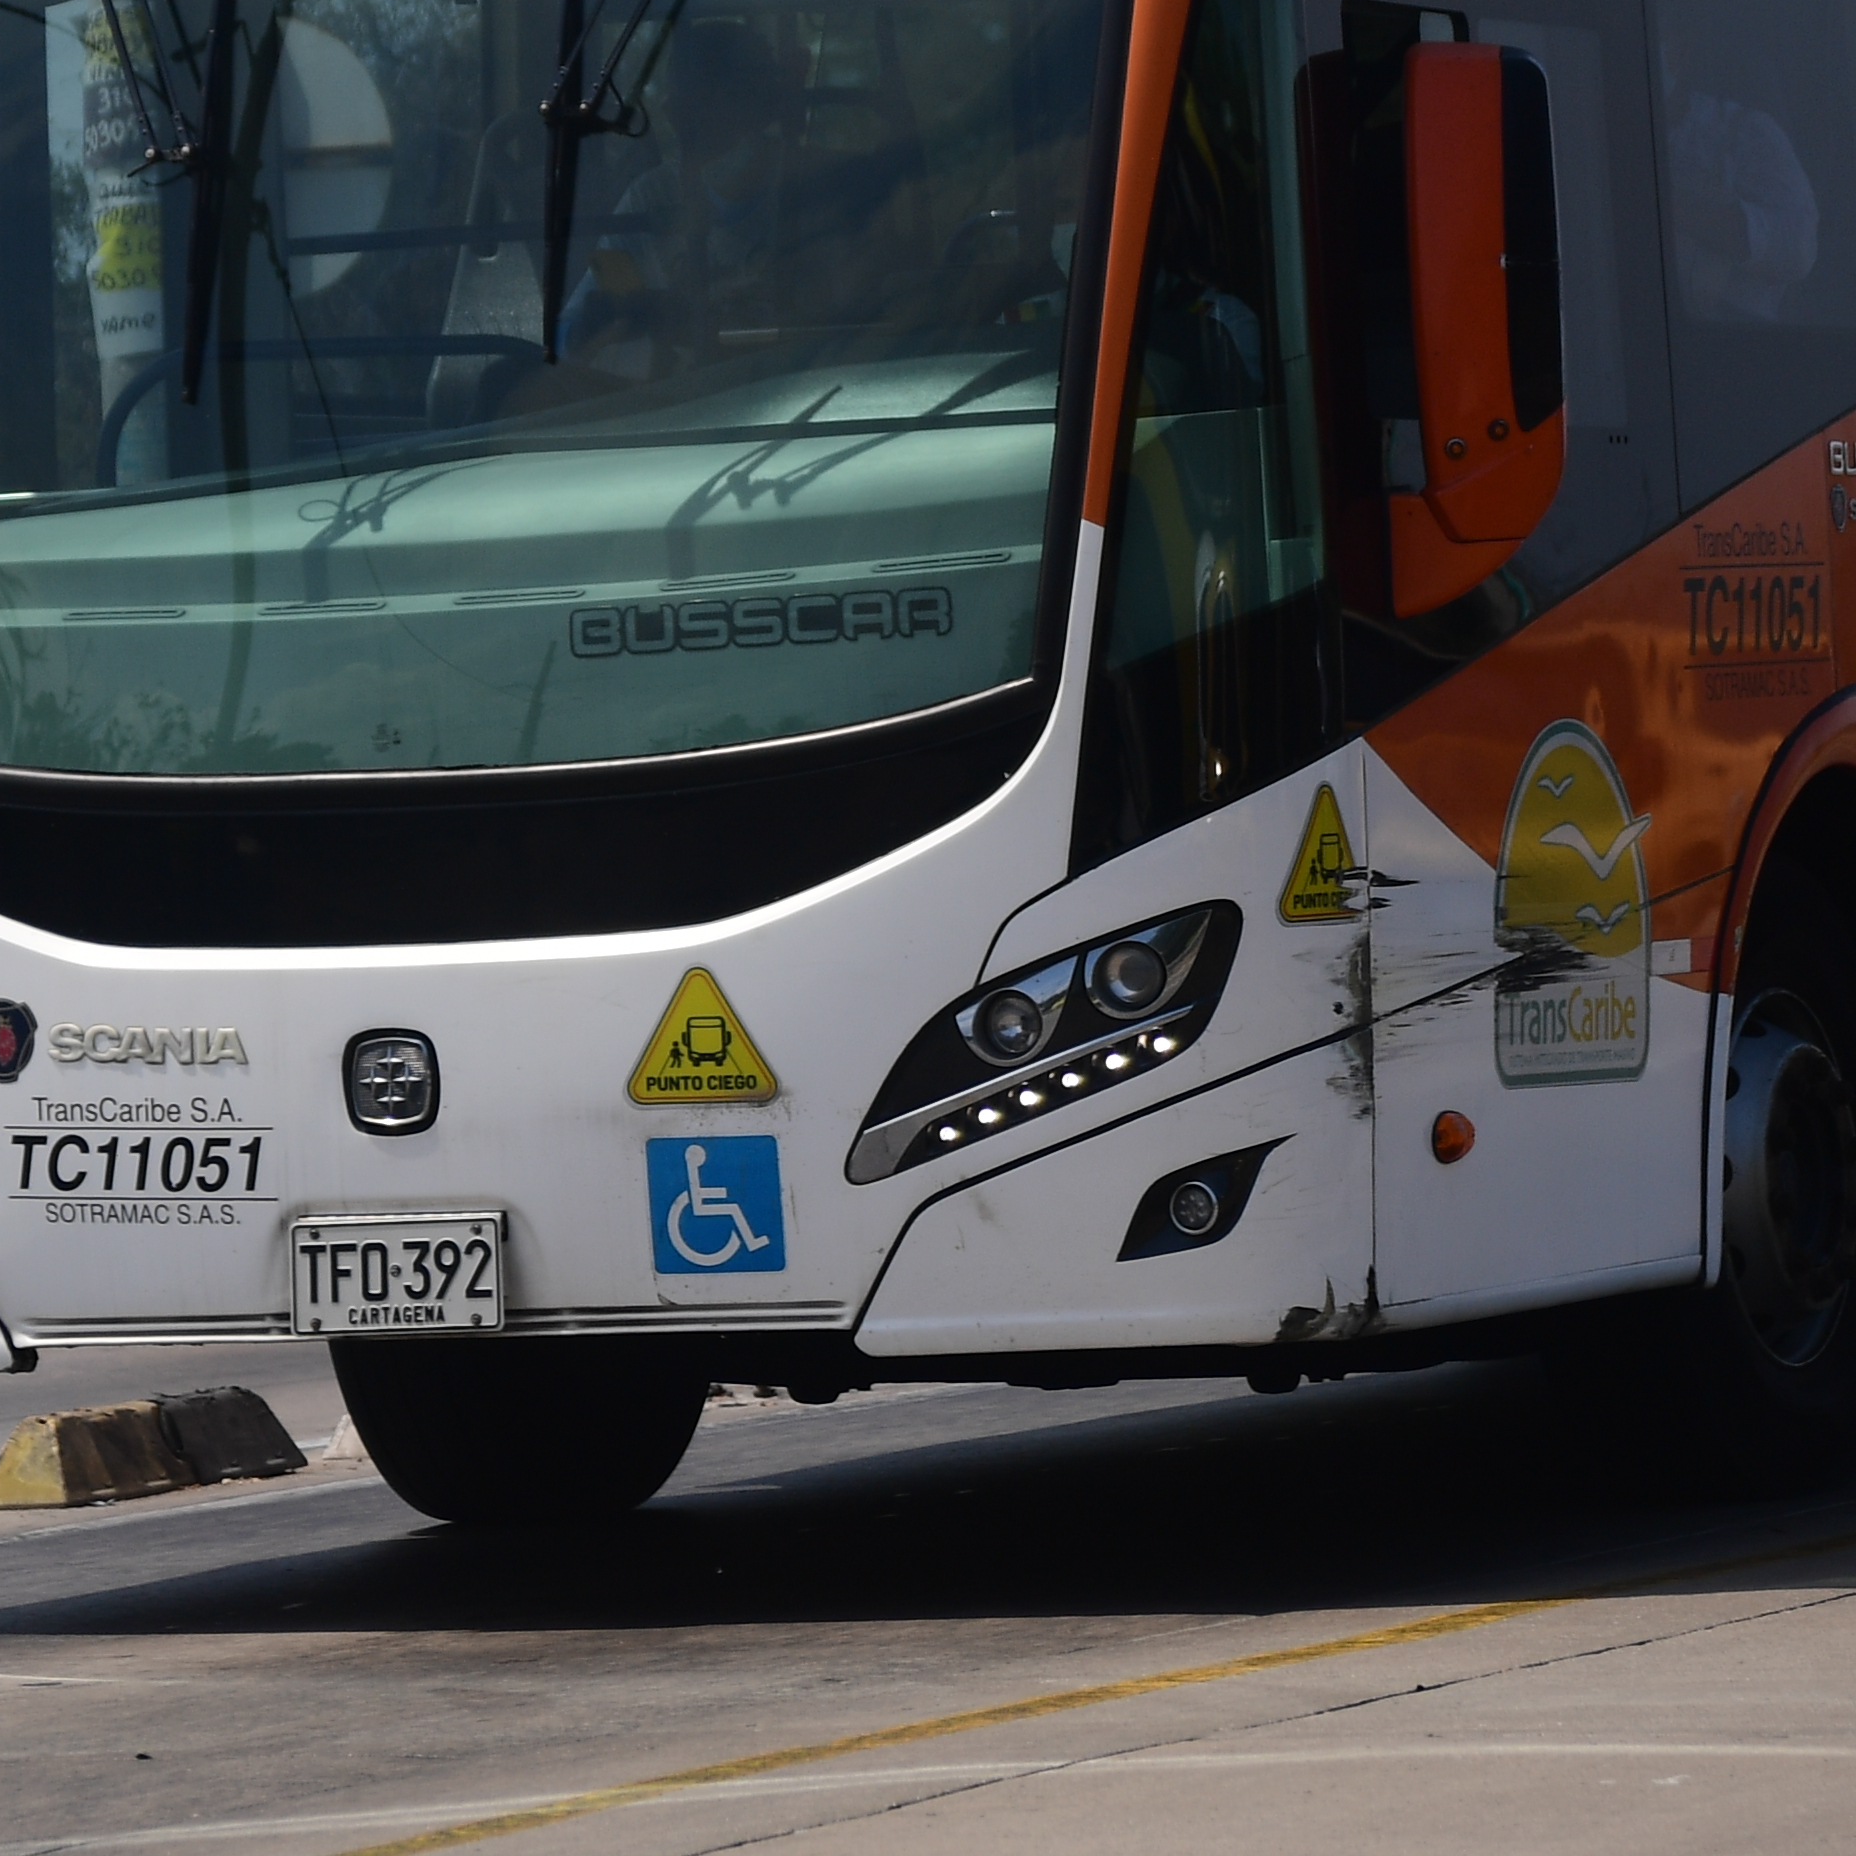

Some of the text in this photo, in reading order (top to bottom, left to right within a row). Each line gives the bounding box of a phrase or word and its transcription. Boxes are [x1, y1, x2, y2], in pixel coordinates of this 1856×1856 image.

[1693, 523, 1777, 558] TransCaribe
[569, 587, 954, 659] BUSSCAR
[1683, 573, 1821, 657] TC11051
[1293, 891, 1329, 910] PUNTO
[1503, 980, 1636, 1046] TransCaribe
[47, 1022, 249, 1066] SCANIA
[646, 1074, 758, 1092] PUNTO CIEGO
[32, 1096, 243, 1124] TransCaribe S.A.
[10, 1135, 263, 1194] TC11051
[44, 1201, 242, 1226] SOTRAMAC S.A.S.
[348, 1304, 446, 1326] CARTAGENA
